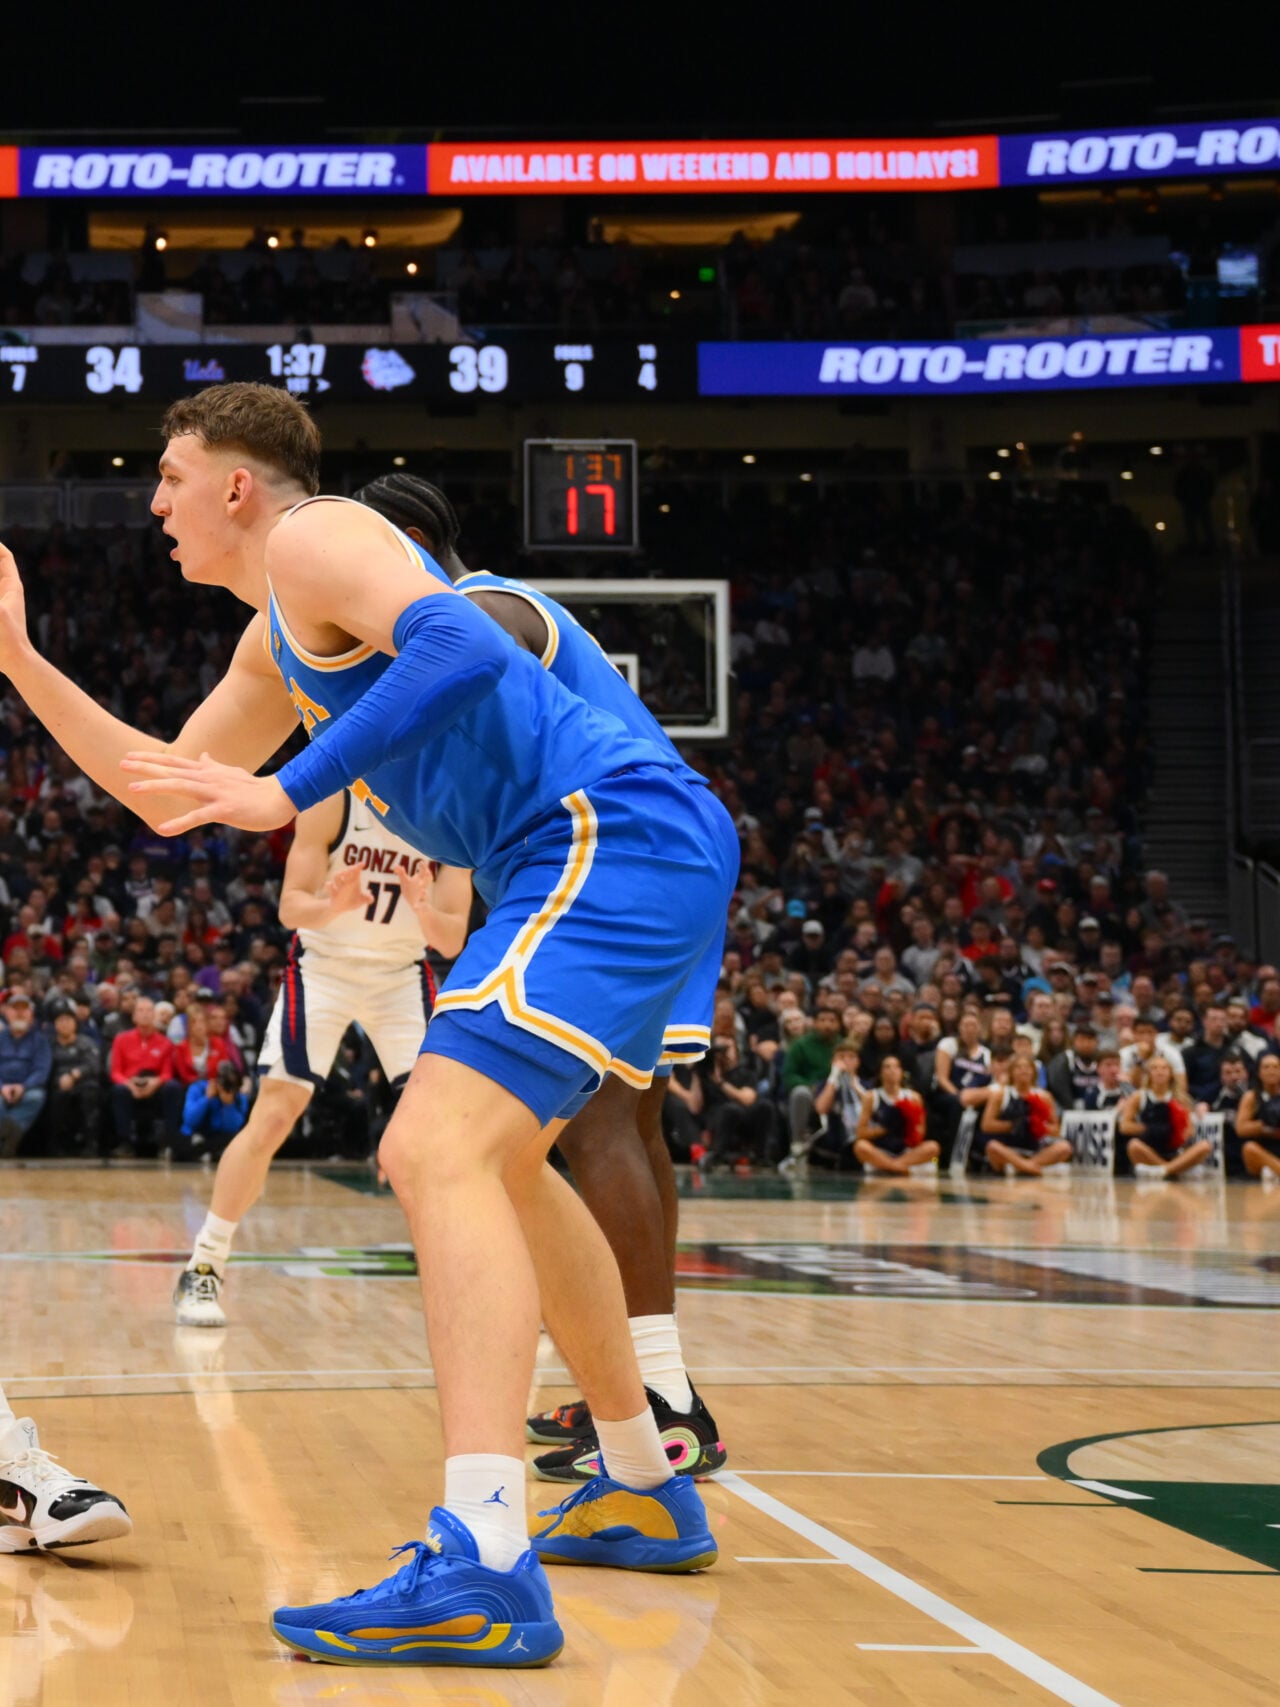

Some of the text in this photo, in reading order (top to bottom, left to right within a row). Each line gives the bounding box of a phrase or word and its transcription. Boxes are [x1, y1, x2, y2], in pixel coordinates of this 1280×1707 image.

[451, 150, 978, 183] AVAILABLE ON WEEKEND AND HOLIDAYS!
[1027, 127, 1280, 176] ROTO-RO
[10, 364, 26, 391] 7
[86, 346, 143, 393] 34
[267, 344, 327, 376] 1:37
[449, 345, 507, 392] 39
[565, 363, 584, 391] 9
[638, 363, 657, 390] 4
[566, 484, 615, 535] 17
[365, 881, 401, 924] 17
